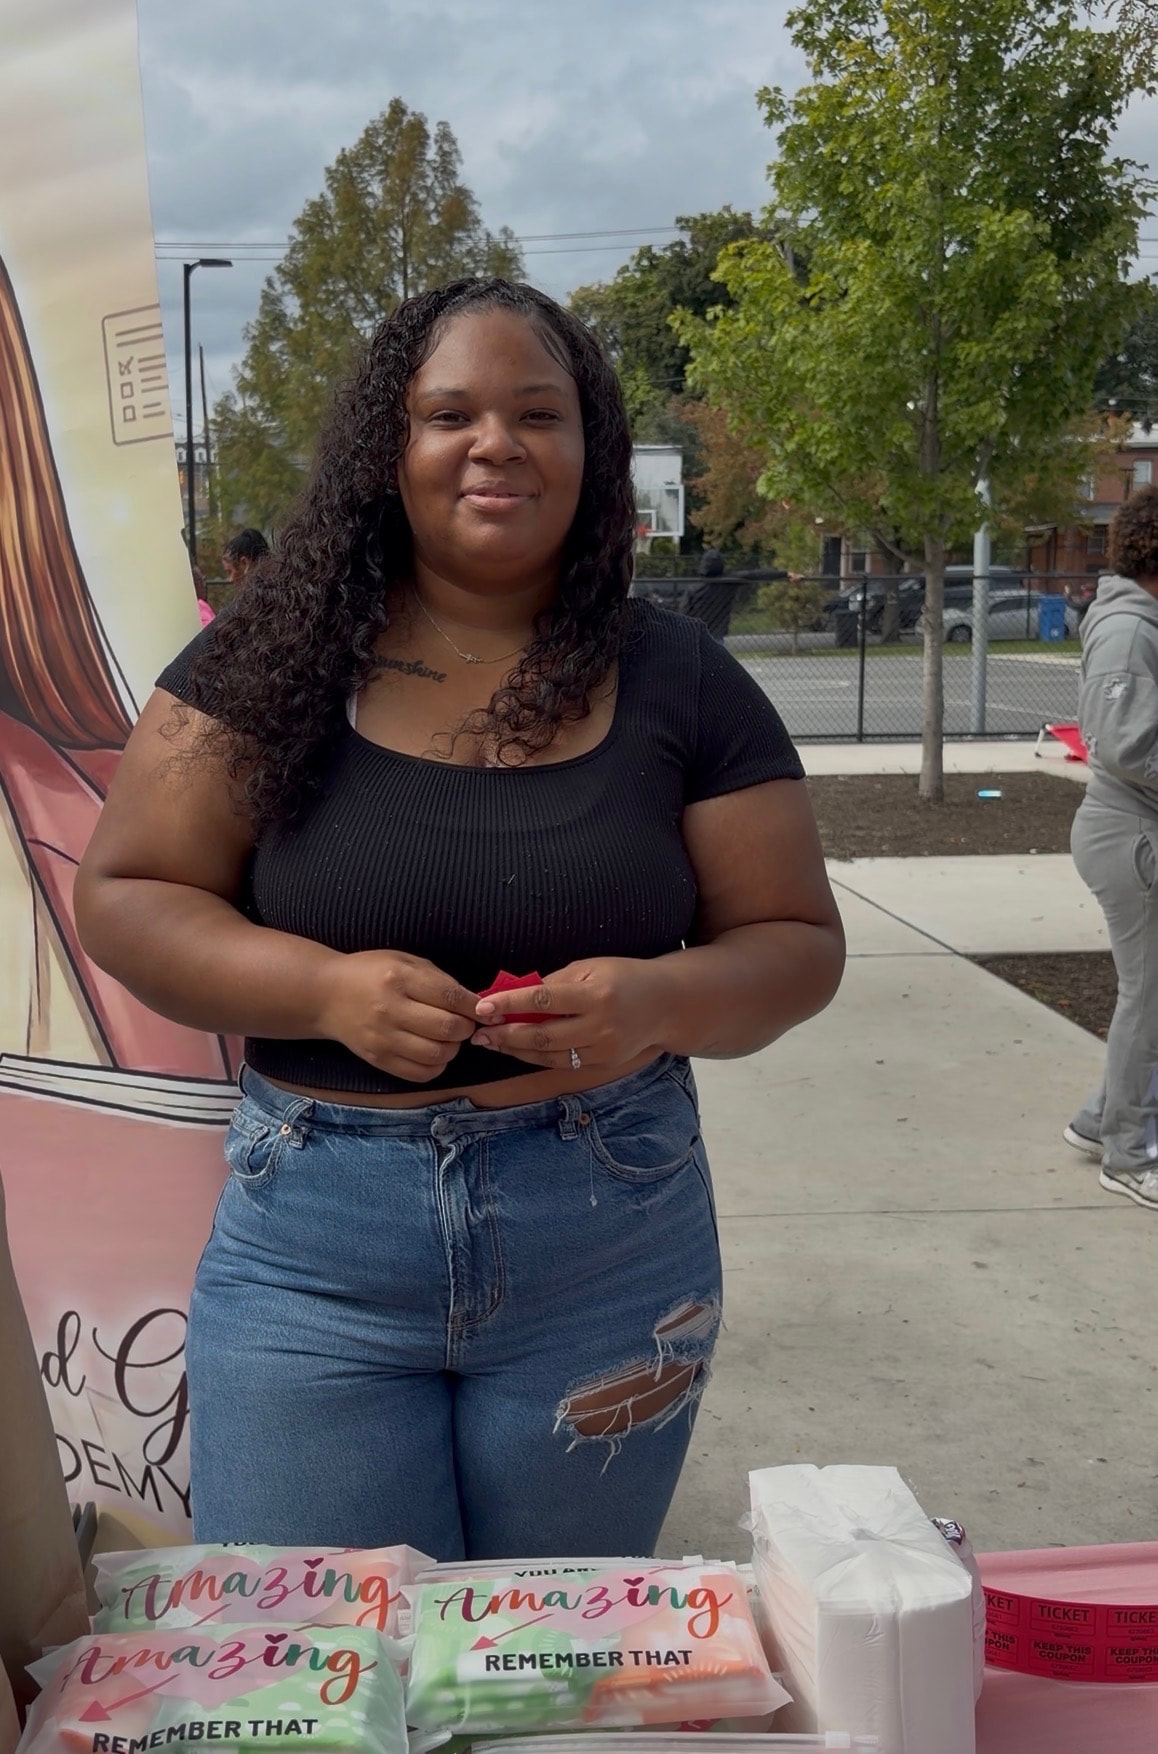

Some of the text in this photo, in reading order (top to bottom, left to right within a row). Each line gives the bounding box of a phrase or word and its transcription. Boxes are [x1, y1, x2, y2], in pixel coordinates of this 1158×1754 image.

[41, 1308, 190, 1466] d G
[56, 1433, 192, 1519] DEMY
[121, 1557, 402, 1631] Amazing
[984, 1593, 1014, 1611] KET
[434, 1577, 733, 1639] Amazing
[1038, 1604, 1090, 1622] TICKET
[1115, 1611, 1158, 1624] TICKE
[985, 1638, 1010, 1650] PON
[1033, 1640, 1091, 1655] KEEP THIS
[1110, 1647, 1158, 1656] KEEP THI
[486, 1650, 693, 1672] REMEMBER THAT
[1038, 1650, 1086, 1662] COUPON
[60, 1633, 378, 1705] Amazing
[92, 1719, 319, 1754] REMEMBER THAT
